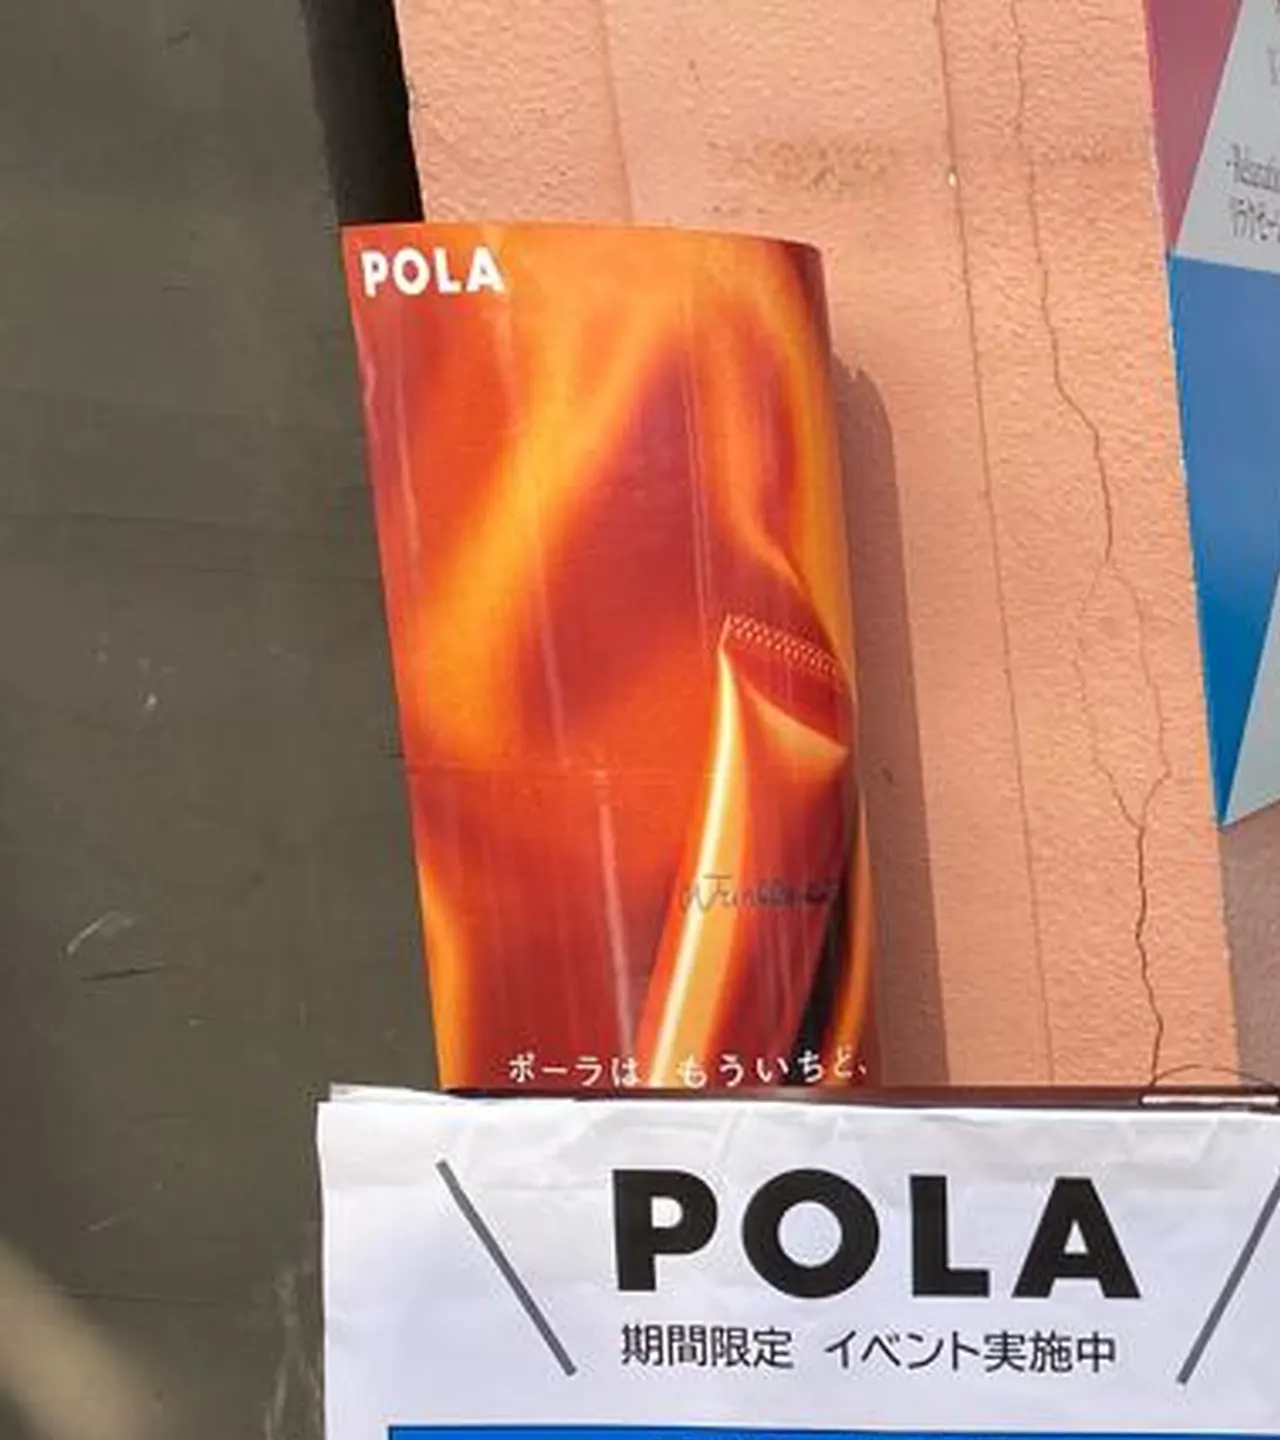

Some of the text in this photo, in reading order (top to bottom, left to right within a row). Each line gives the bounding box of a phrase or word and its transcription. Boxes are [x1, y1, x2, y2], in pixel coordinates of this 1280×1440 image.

[360, 246, 507, 299] POLA
[612, 1168, 1141, 1299] POLA
[620, 1324, 1117, 1374] 期間限定 イベント実施中
